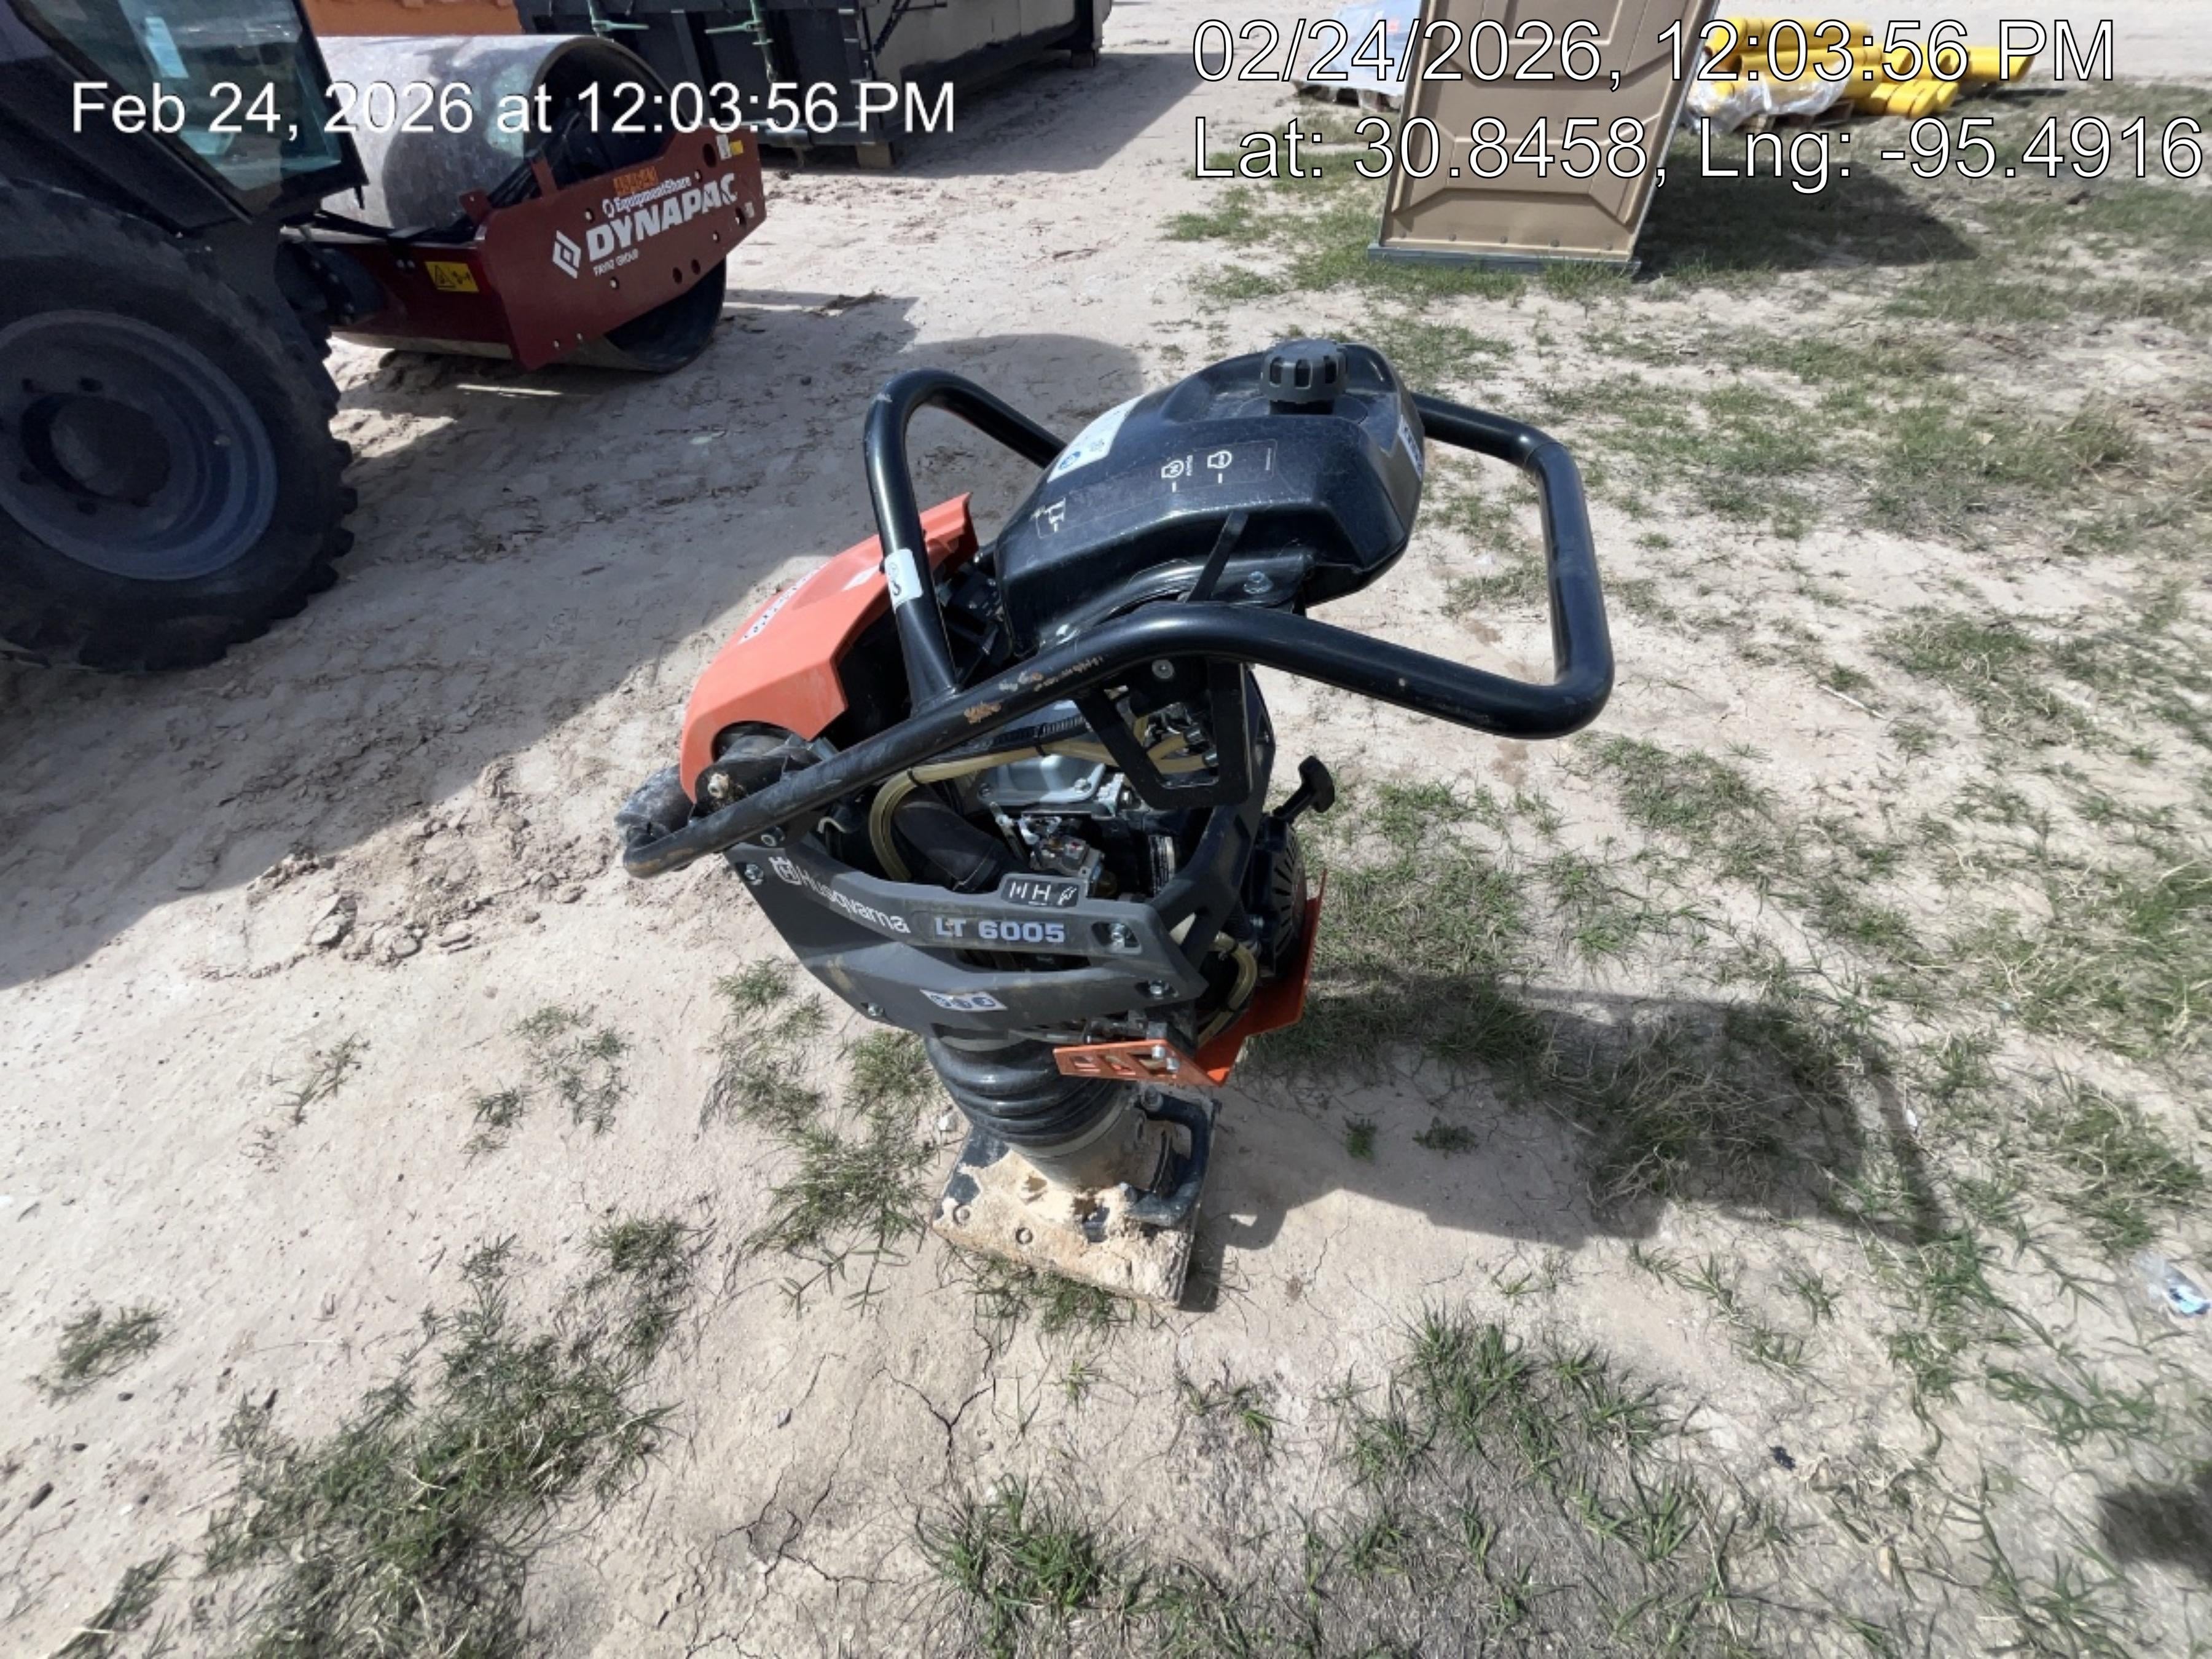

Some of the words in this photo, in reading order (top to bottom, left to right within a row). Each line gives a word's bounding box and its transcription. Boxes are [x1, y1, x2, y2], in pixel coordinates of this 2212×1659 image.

[586, 172, 738, 262] DYNAPAC
[934, 917, 967, 938] LT
[978, 919, 1065, 943] 6005
